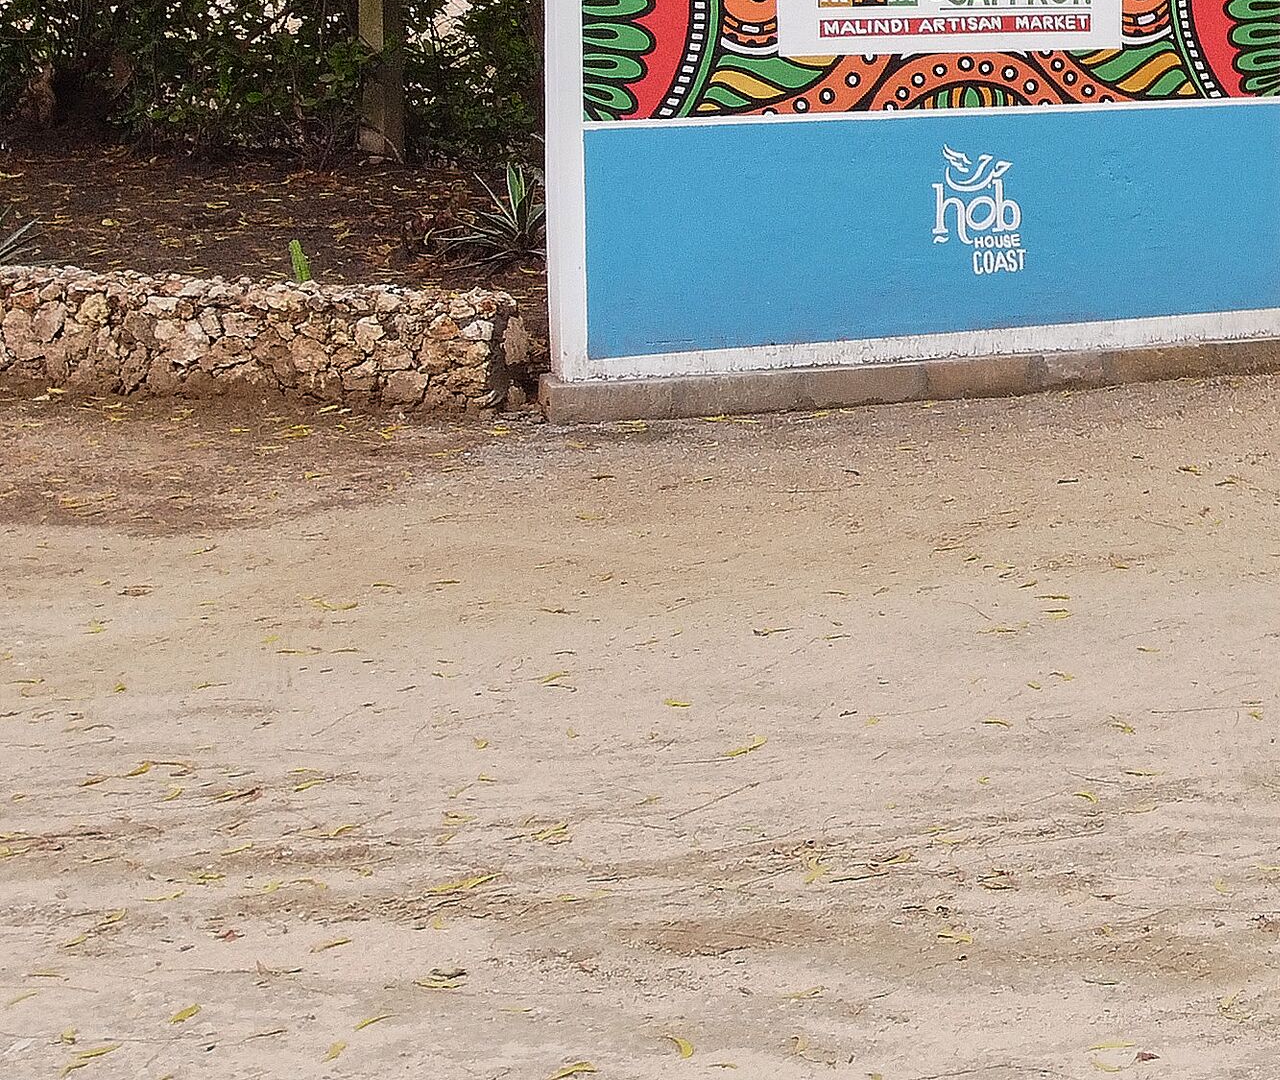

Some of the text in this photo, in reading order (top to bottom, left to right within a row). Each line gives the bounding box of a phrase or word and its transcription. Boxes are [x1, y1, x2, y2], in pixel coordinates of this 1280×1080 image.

[822, 13, 1090, 36] MALINDI ARTISAN MARKET
[931, 178, 1022, 245] hob
[973, 233, 1021, 249] HOUSE
[972, 248, 1027, 275] COAST
